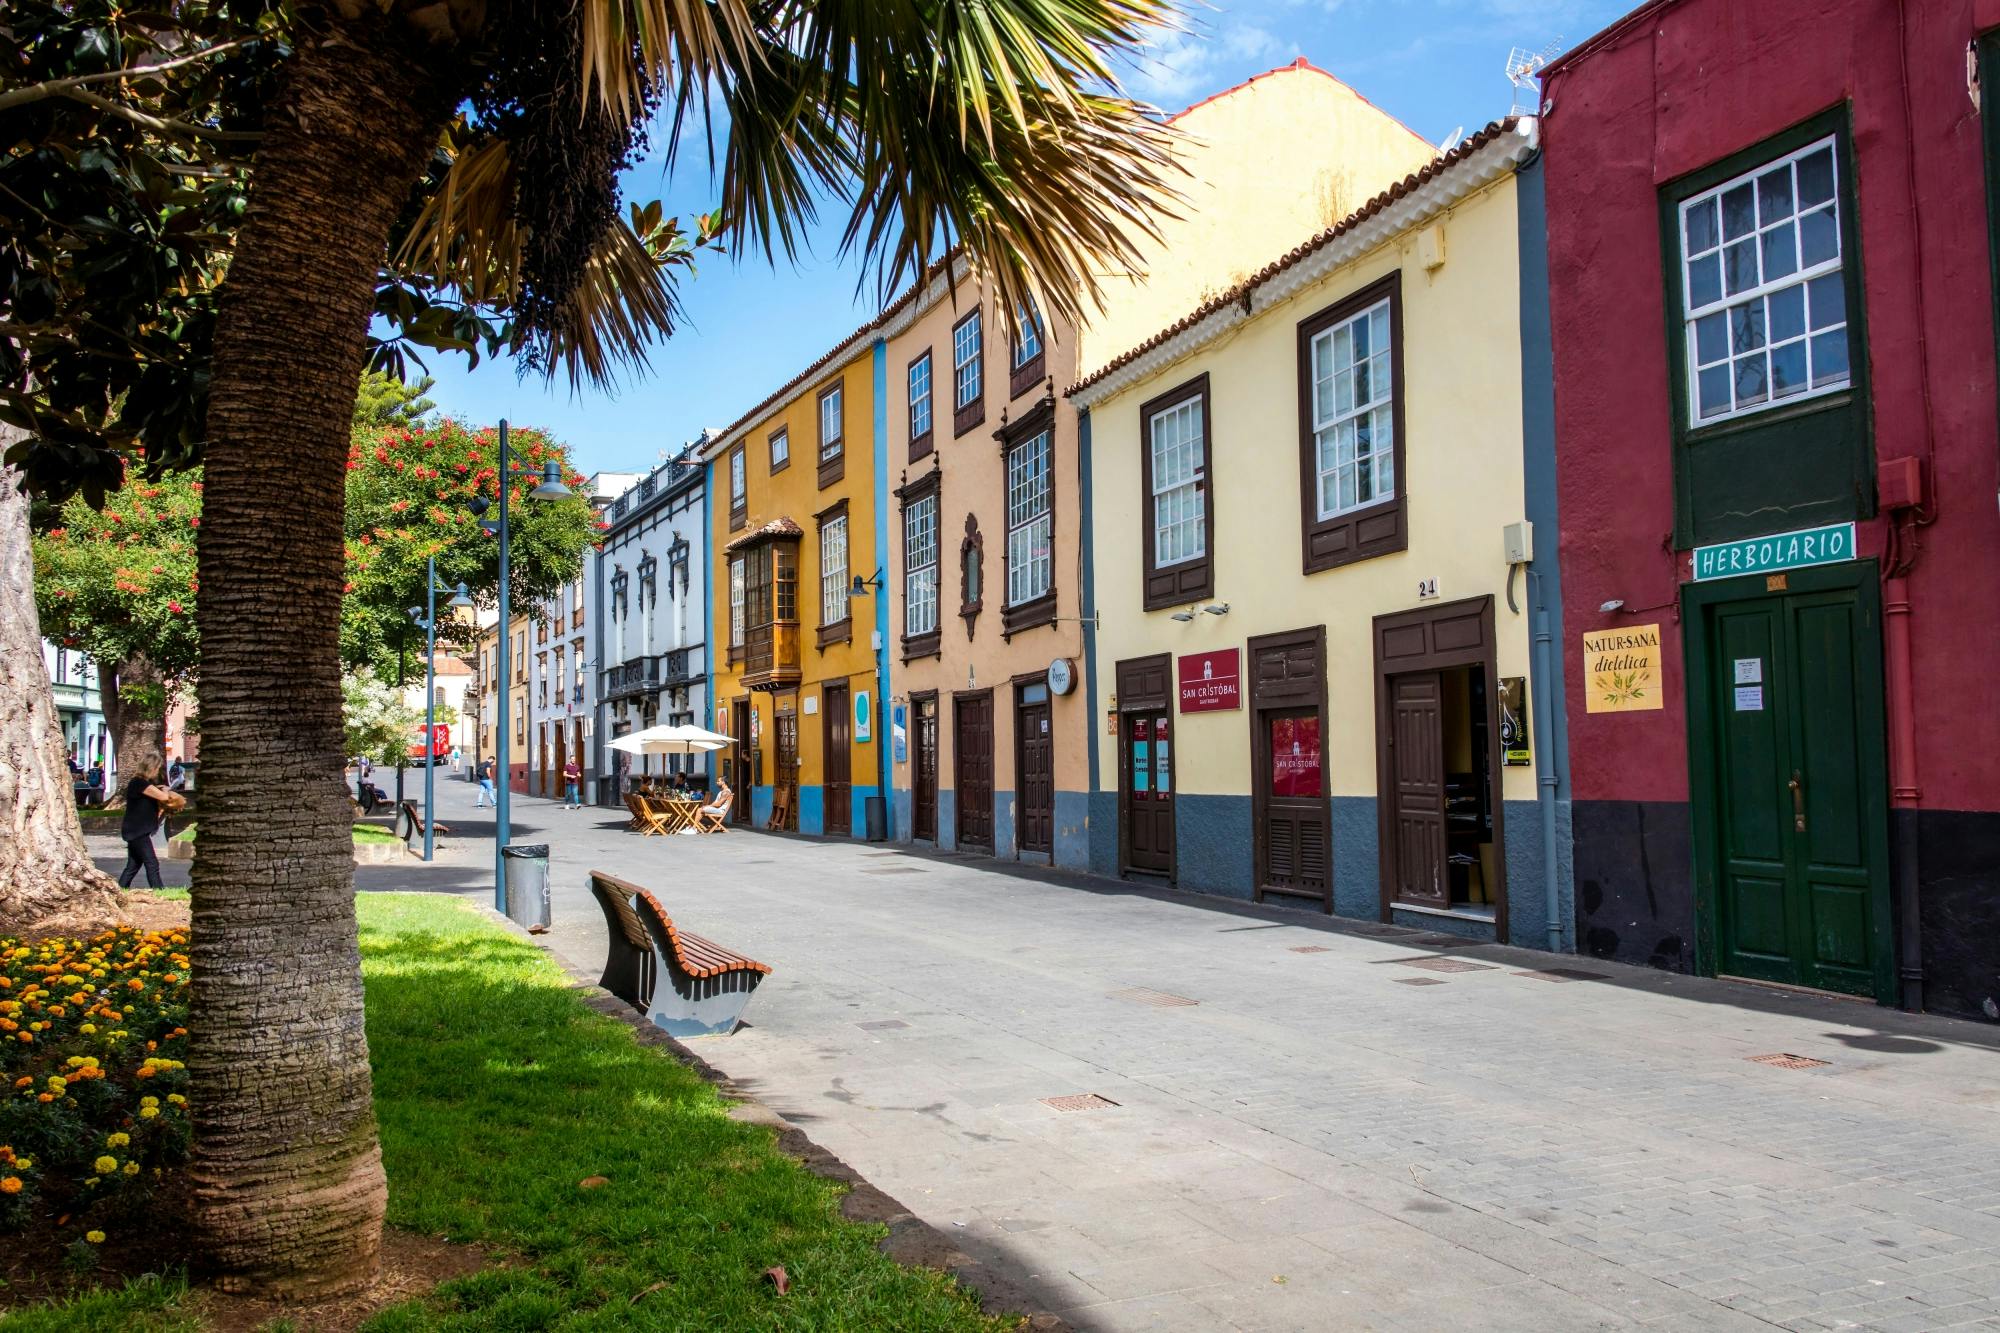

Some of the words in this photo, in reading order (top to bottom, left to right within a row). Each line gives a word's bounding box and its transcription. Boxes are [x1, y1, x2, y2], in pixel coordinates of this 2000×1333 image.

[1703, 531, 1843, 575] HERBOLARIO
[1419, 579, 1435, 598] 24
[1585, 632, 1657, 653] NATUR-SANA
[1182, 689, 1196, 699] SAN
[1198, 683, 1237, 697] CRISTÓBAL
[1276, 760, 1287, 768] SAN
